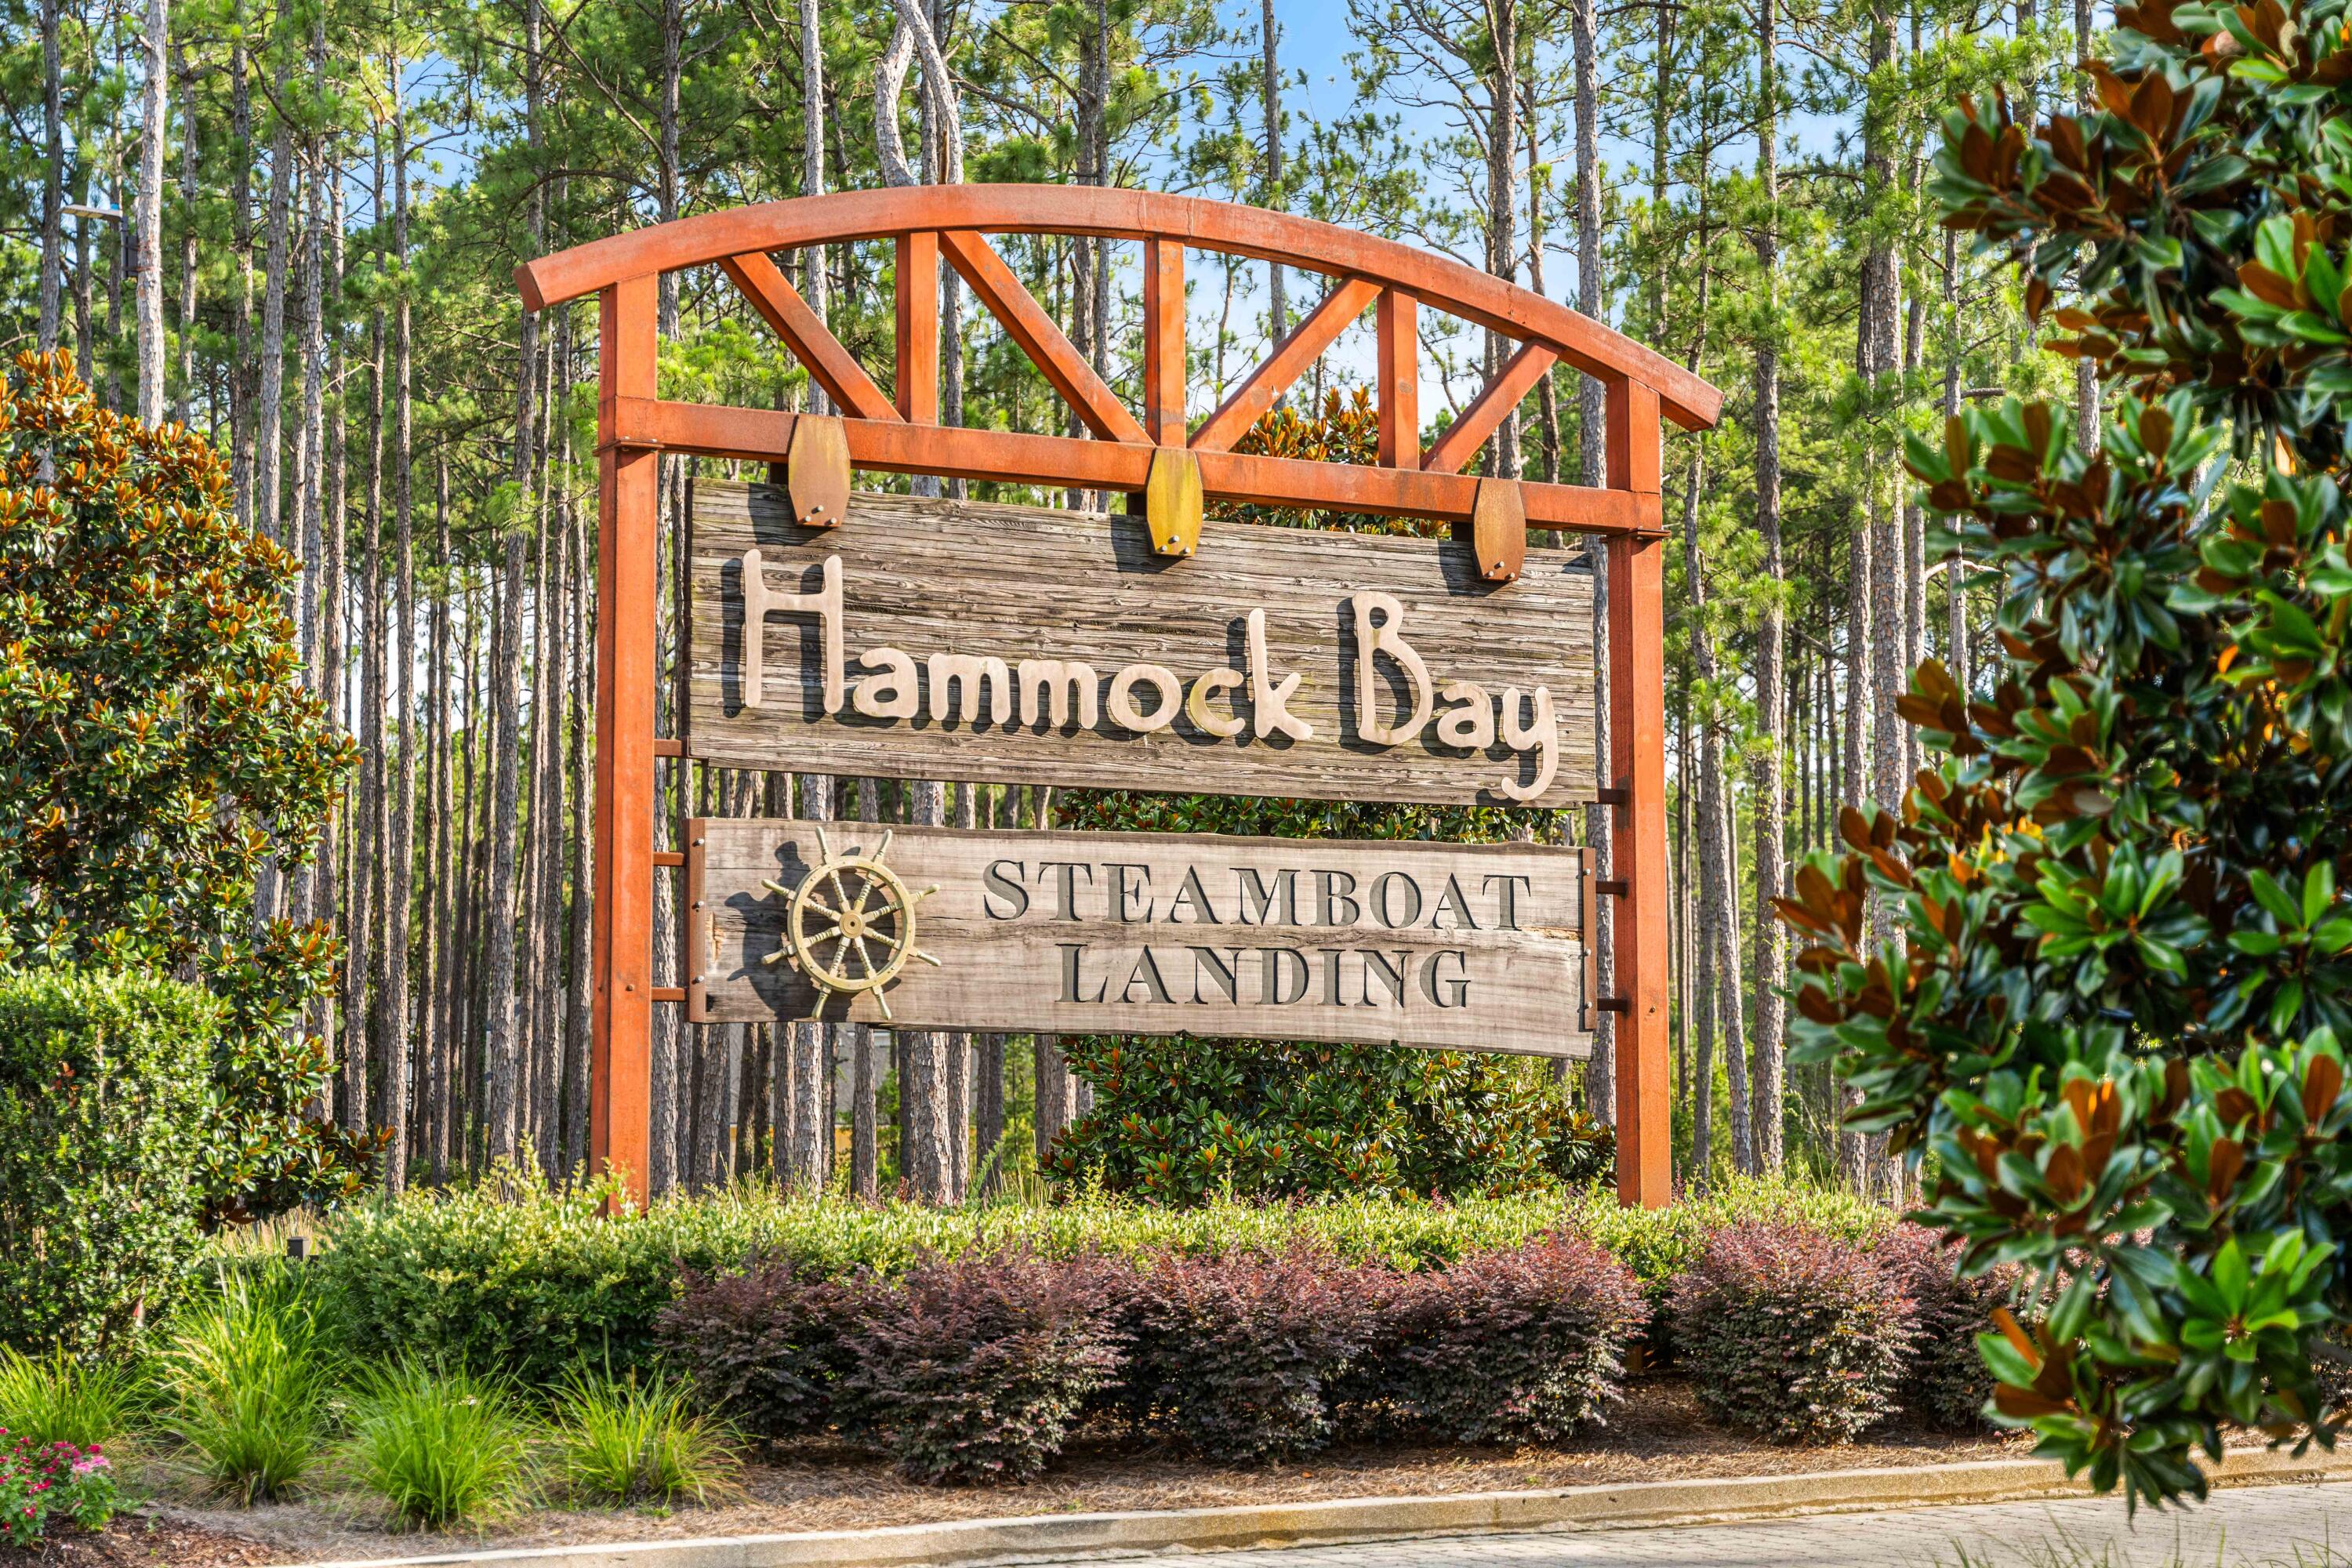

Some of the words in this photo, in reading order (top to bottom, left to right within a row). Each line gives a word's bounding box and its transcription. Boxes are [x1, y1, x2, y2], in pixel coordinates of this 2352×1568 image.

[743, 549, 1312, 740] Hammock
[1352, 590, 1559, 801] Bay
[982, 859, 1530, 931] STEAMBOAT
[1054, 943, 1471, 1009] LANDING
